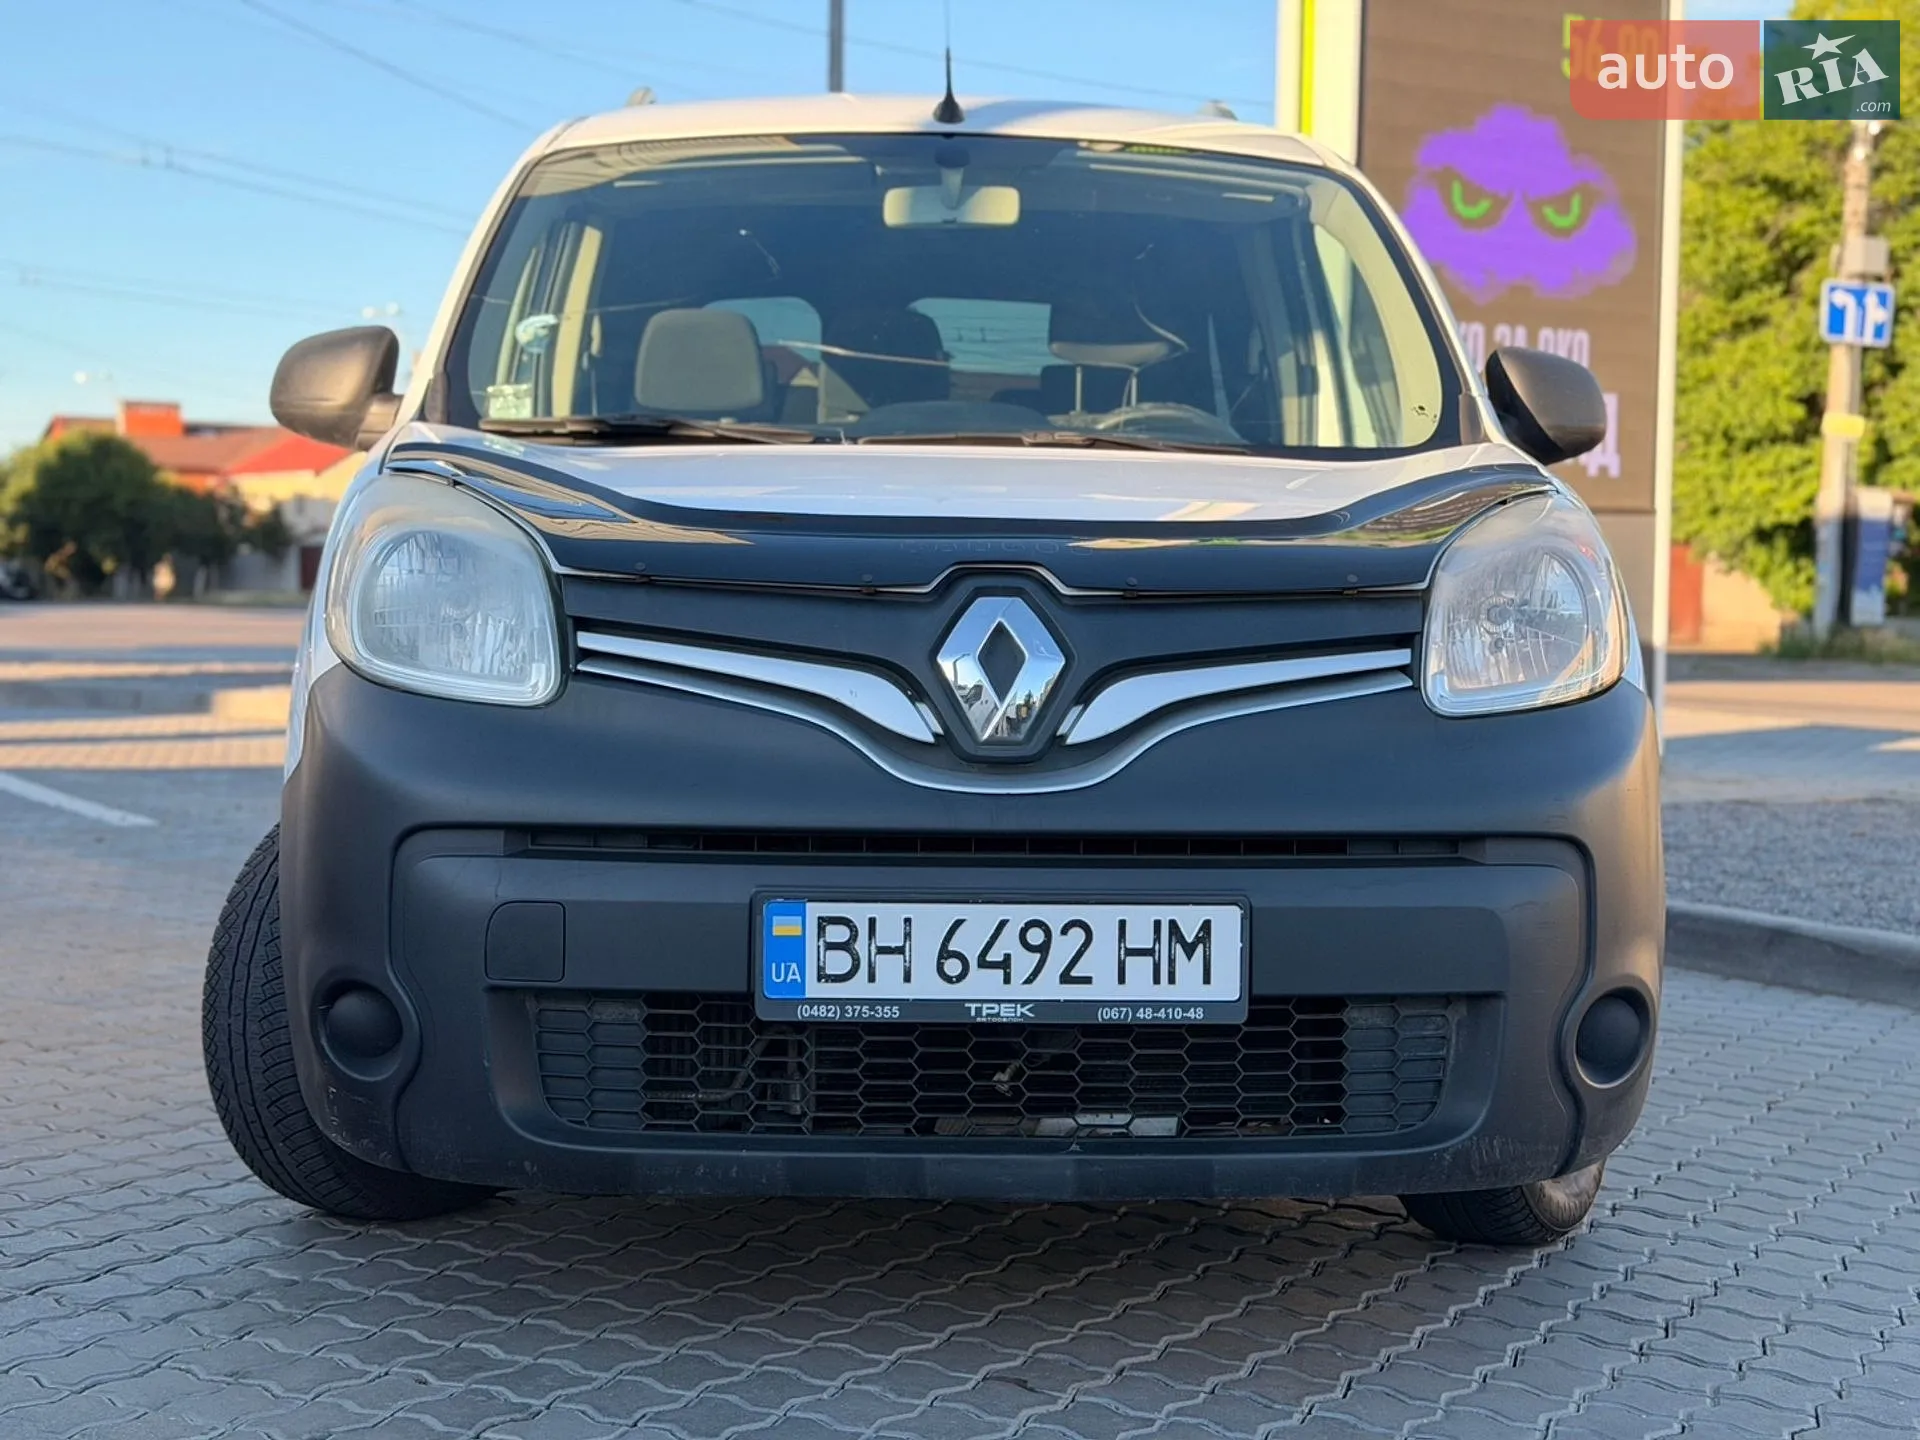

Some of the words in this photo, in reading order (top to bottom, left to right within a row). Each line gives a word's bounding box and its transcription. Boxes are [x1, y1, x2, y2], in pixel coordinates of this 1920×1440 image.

[816, 915, 913, 984] BH
[935, 917, 1094, 985] 6492
[1117, 918, 1212, 985] HM
[771, 961, 802, 983] UA
[797, 1004, 841, 1020] (0482)
[844, 1005, 900, 1018] 375-355
[1097, 1006, 1133, 1022] (067)
[1136, 1007, 1205, 1020] 48-410-48
